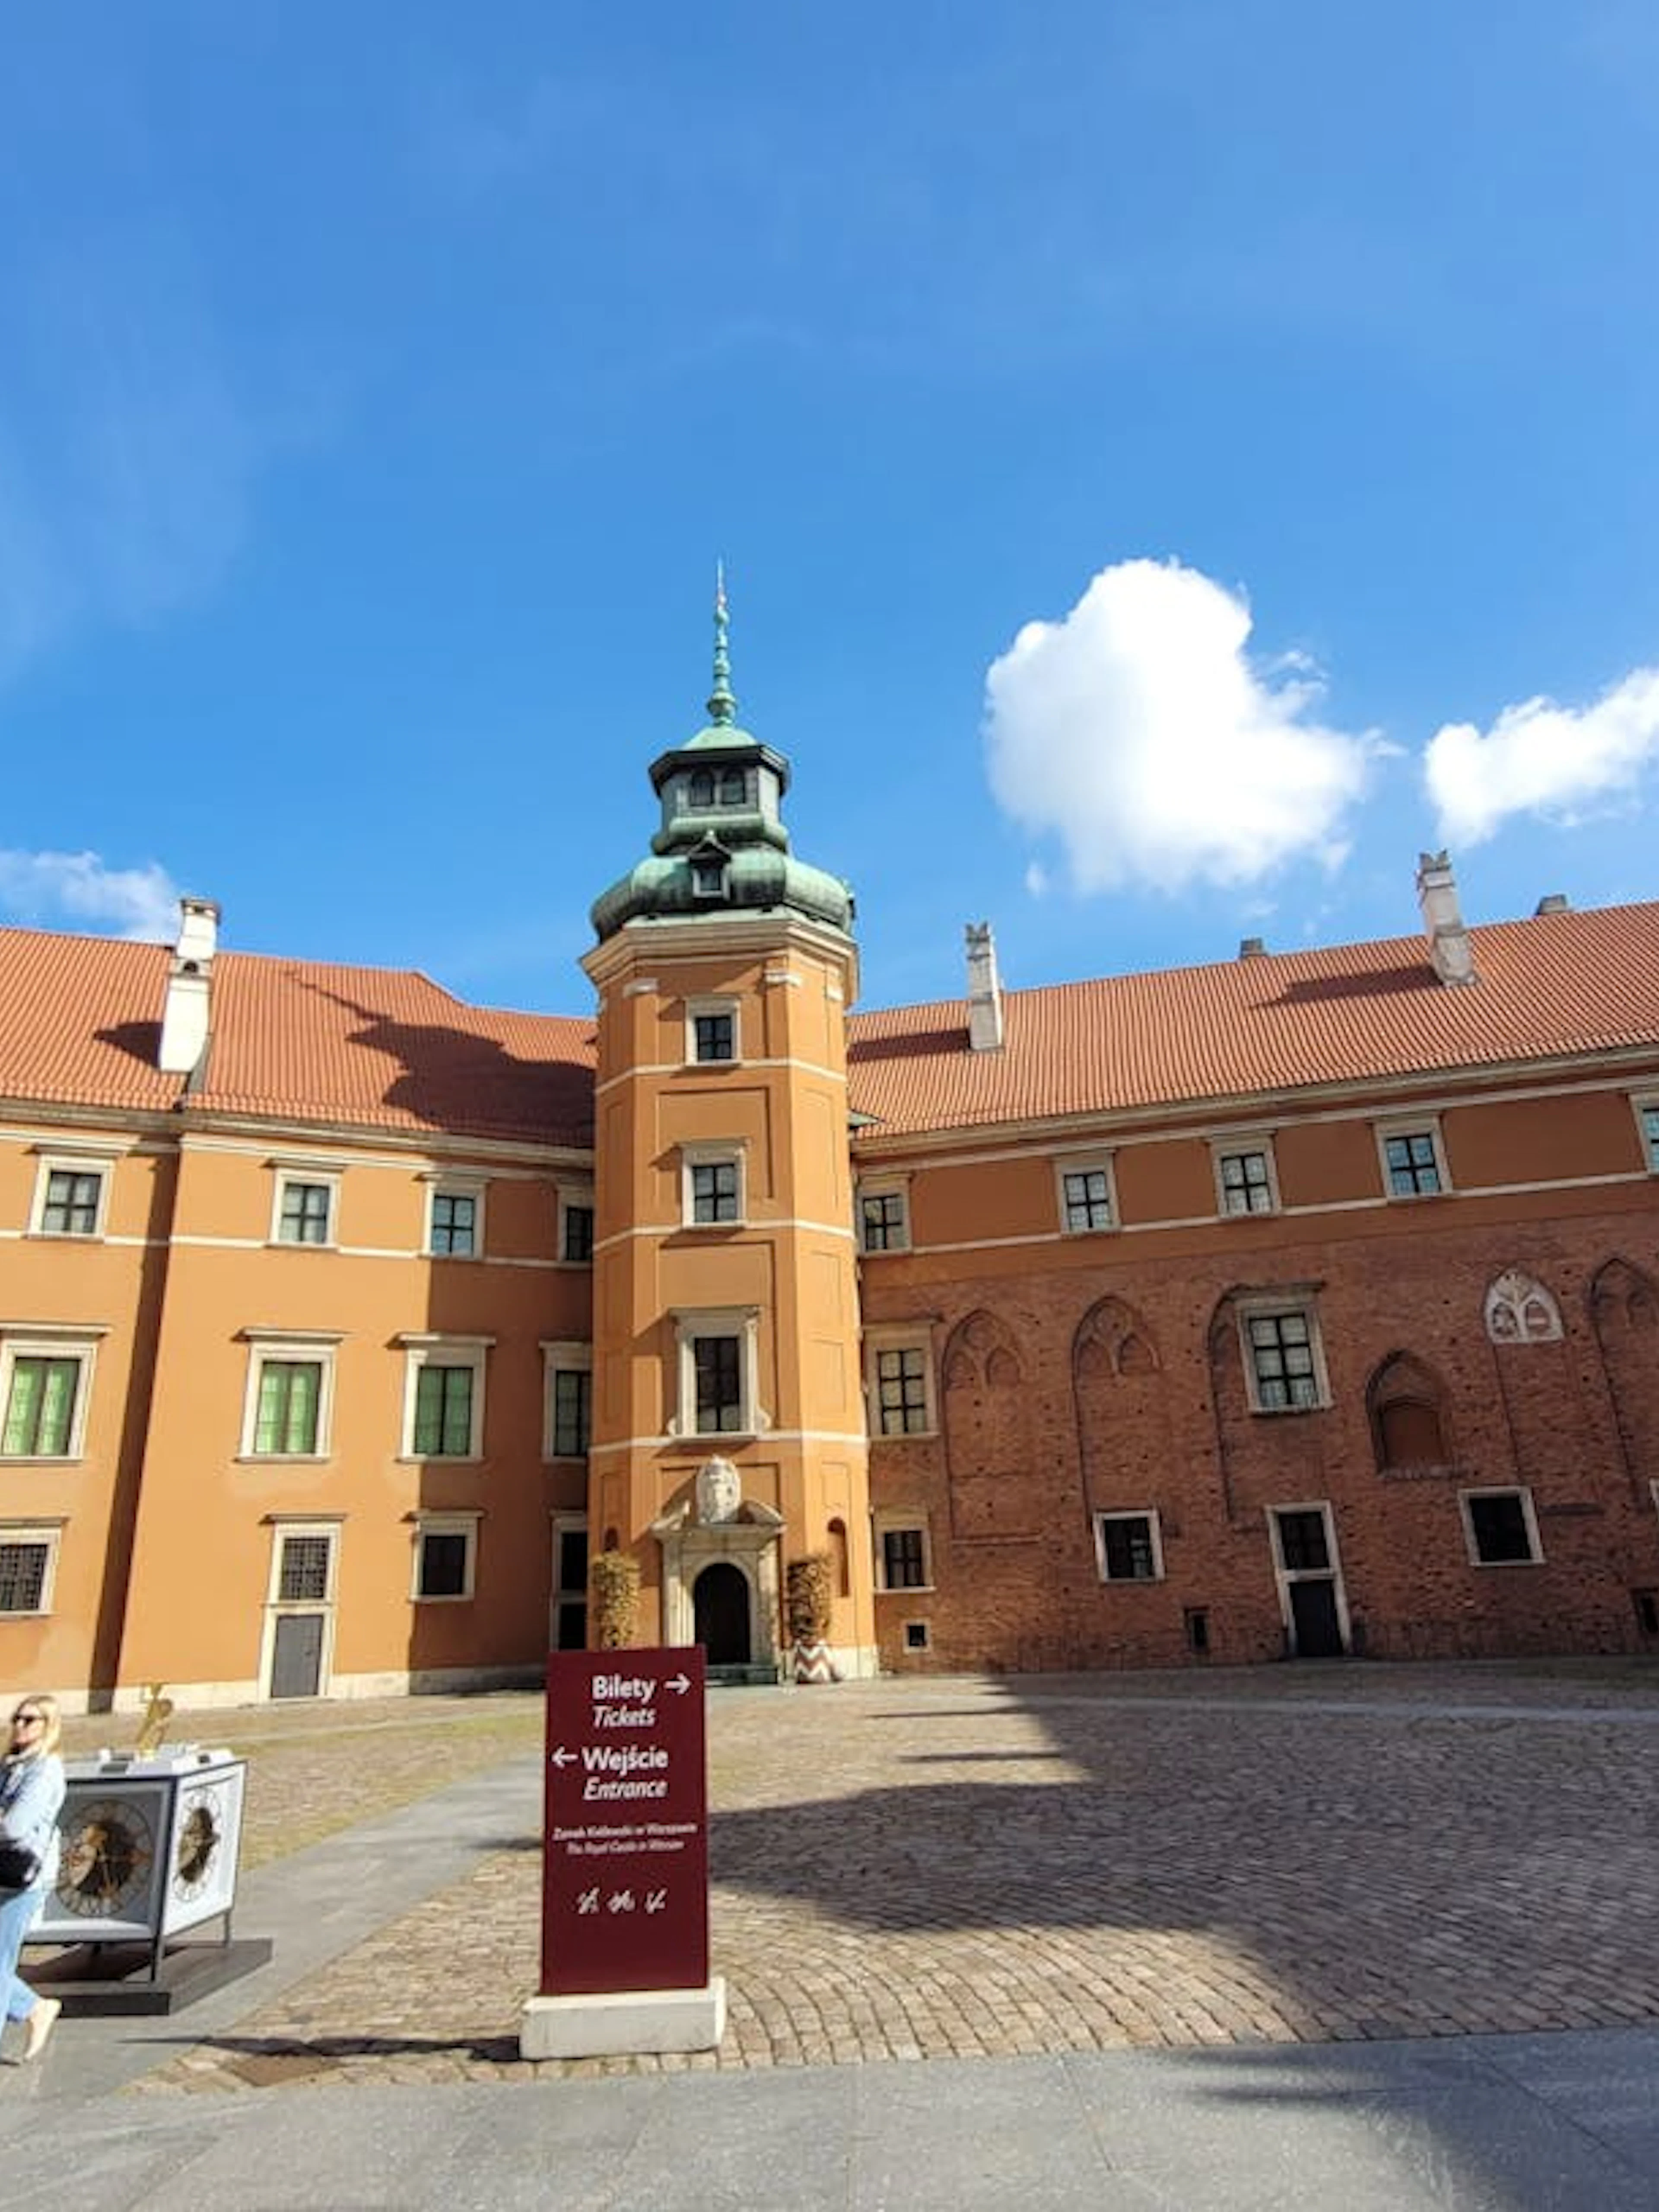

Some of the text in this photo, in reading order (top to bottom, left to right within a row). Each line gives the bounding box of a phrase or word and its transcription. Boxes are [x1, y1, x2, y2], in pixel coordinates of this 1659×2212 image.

[592, 1674, 656, 1703] Bilety
[593, 1705, 655, 1727] Tickets
[582, 1745, 669, 1776] Wejście
[583, 1776, 668, 1800] Entrance
